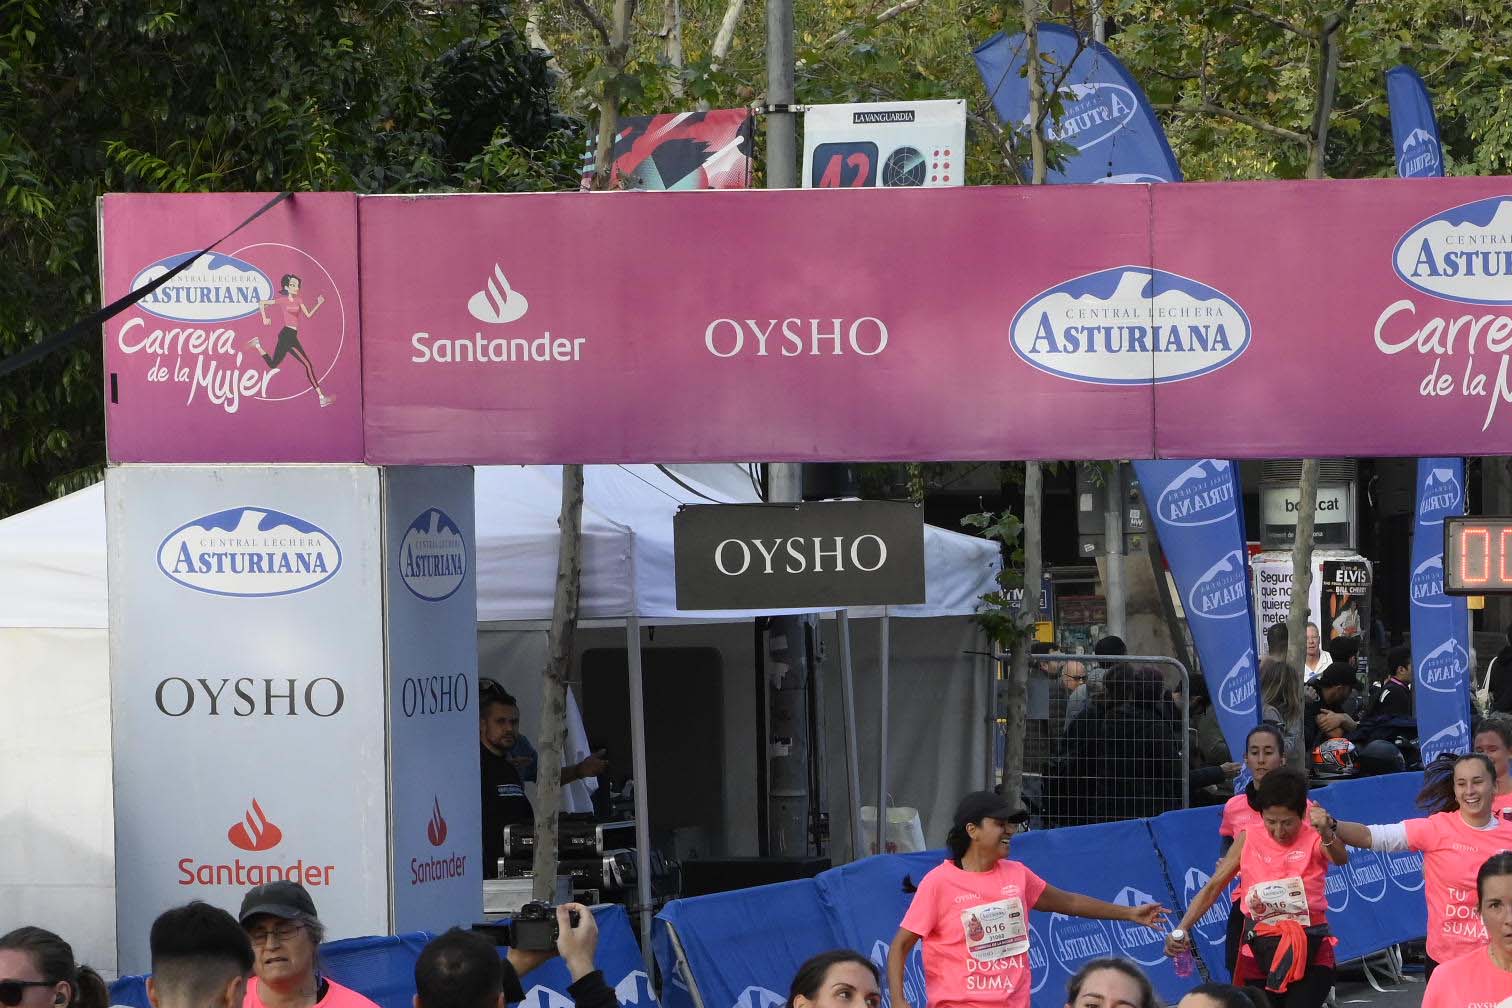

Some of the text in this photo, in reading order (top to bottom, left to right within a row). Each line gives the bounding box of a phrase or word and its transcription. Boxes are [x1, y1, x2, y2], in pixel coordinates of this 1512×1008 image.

[865, 111, 914, 122] VANGUARDIA
[169, 273, 257, 284] ENTRAL LECHERA
[1065, 306, 1224, 319] CENTRAL LECHERA
[118, 319, 235, 353] Carrera
[412, 331, 586, 363] Santander
[705, 317, 888, 358] OYSHO
[1029, 311, 1232, 354] ASTURIANA
[147, 352, 281, 413] de la Mujer
[1420, 358, 1454, 396] de
[1462, 357, 1486, 396] la
[172, 540, 328, 575] ASTURIANA
[200, 538, 322, 548] CENTRAL LECHERA
[714, 534, 887, 576] OYSHO
[404, 542, 463, 578] ASTURIANA
[1336, 570, 1366, 582] ELVIS
[1261, 588, 1277, 597] que
[1262, 599, 1292, 610] quiere
[154, 677, 345, 718] OYSHO
[402, 673, 468, 718] OYSHO
[178, 857, 335, 886] Santander
[411, 853, 466, 886] Santander
[1448, 888, 1466, 902] TU
[985, 923, 1006, 934] 016
[1443, 920, 1488, 938] SUMA
[1056, 931, 1109, 961] ASTURIANA
[967, 975, 1014, 990] SUMA
